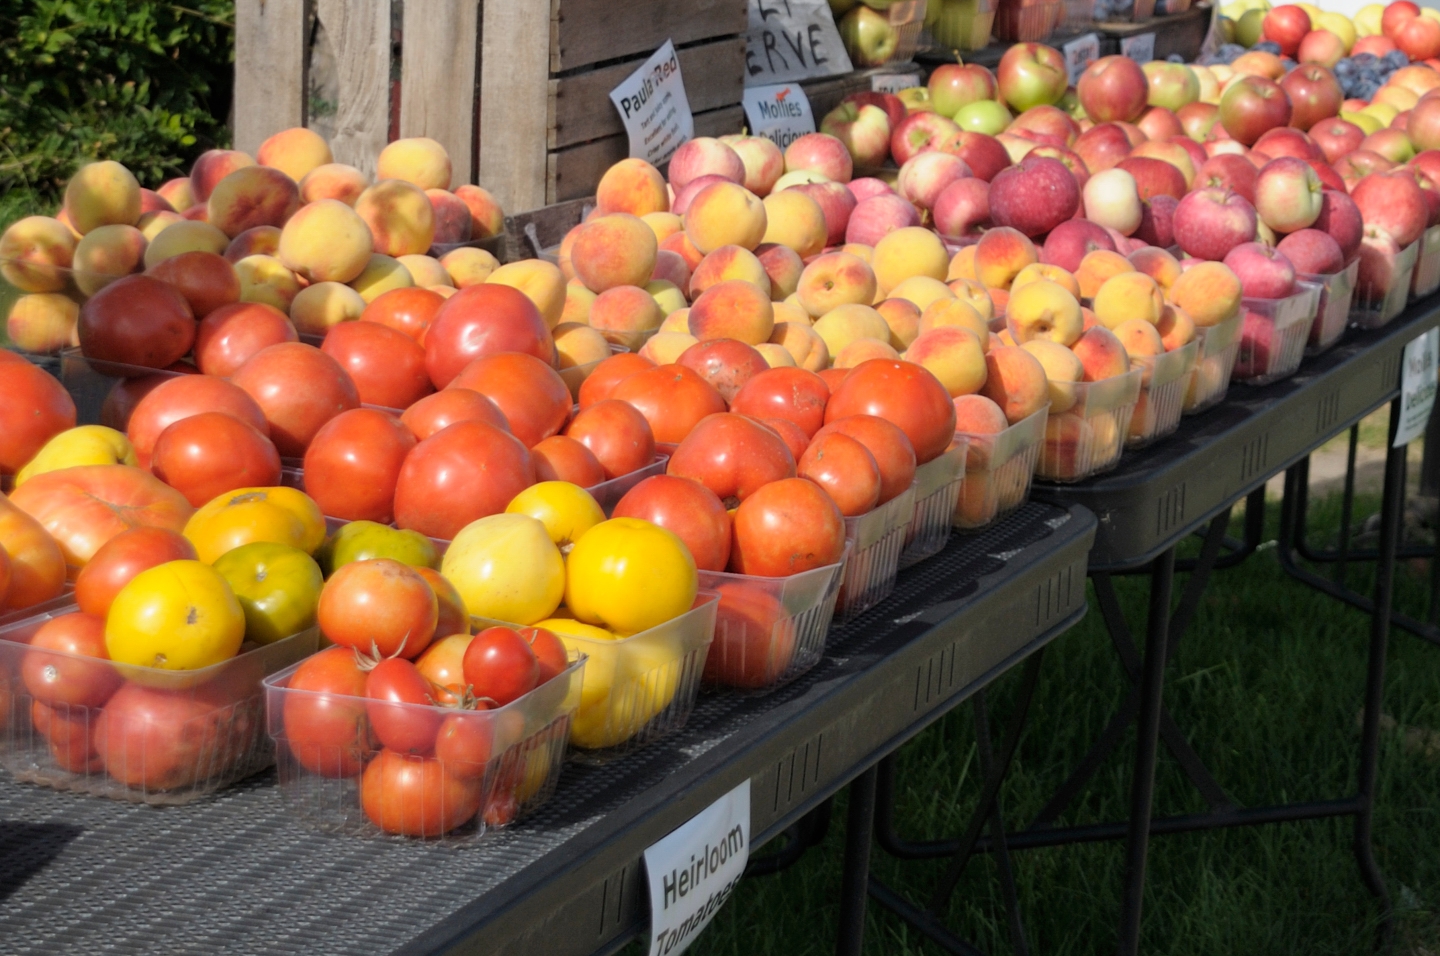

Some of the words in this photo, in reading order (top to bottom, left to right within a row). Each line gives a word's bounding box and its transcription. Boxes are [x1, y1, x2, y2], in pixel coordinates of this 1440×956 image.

[746, 23, 828, 77] ERVE
[620, 78, 654, 119] Paula
[654, 50, 677, 86] Red
[758, 98, 802, 120] Mollies
[663, 823, 744, 910] Heirloom
